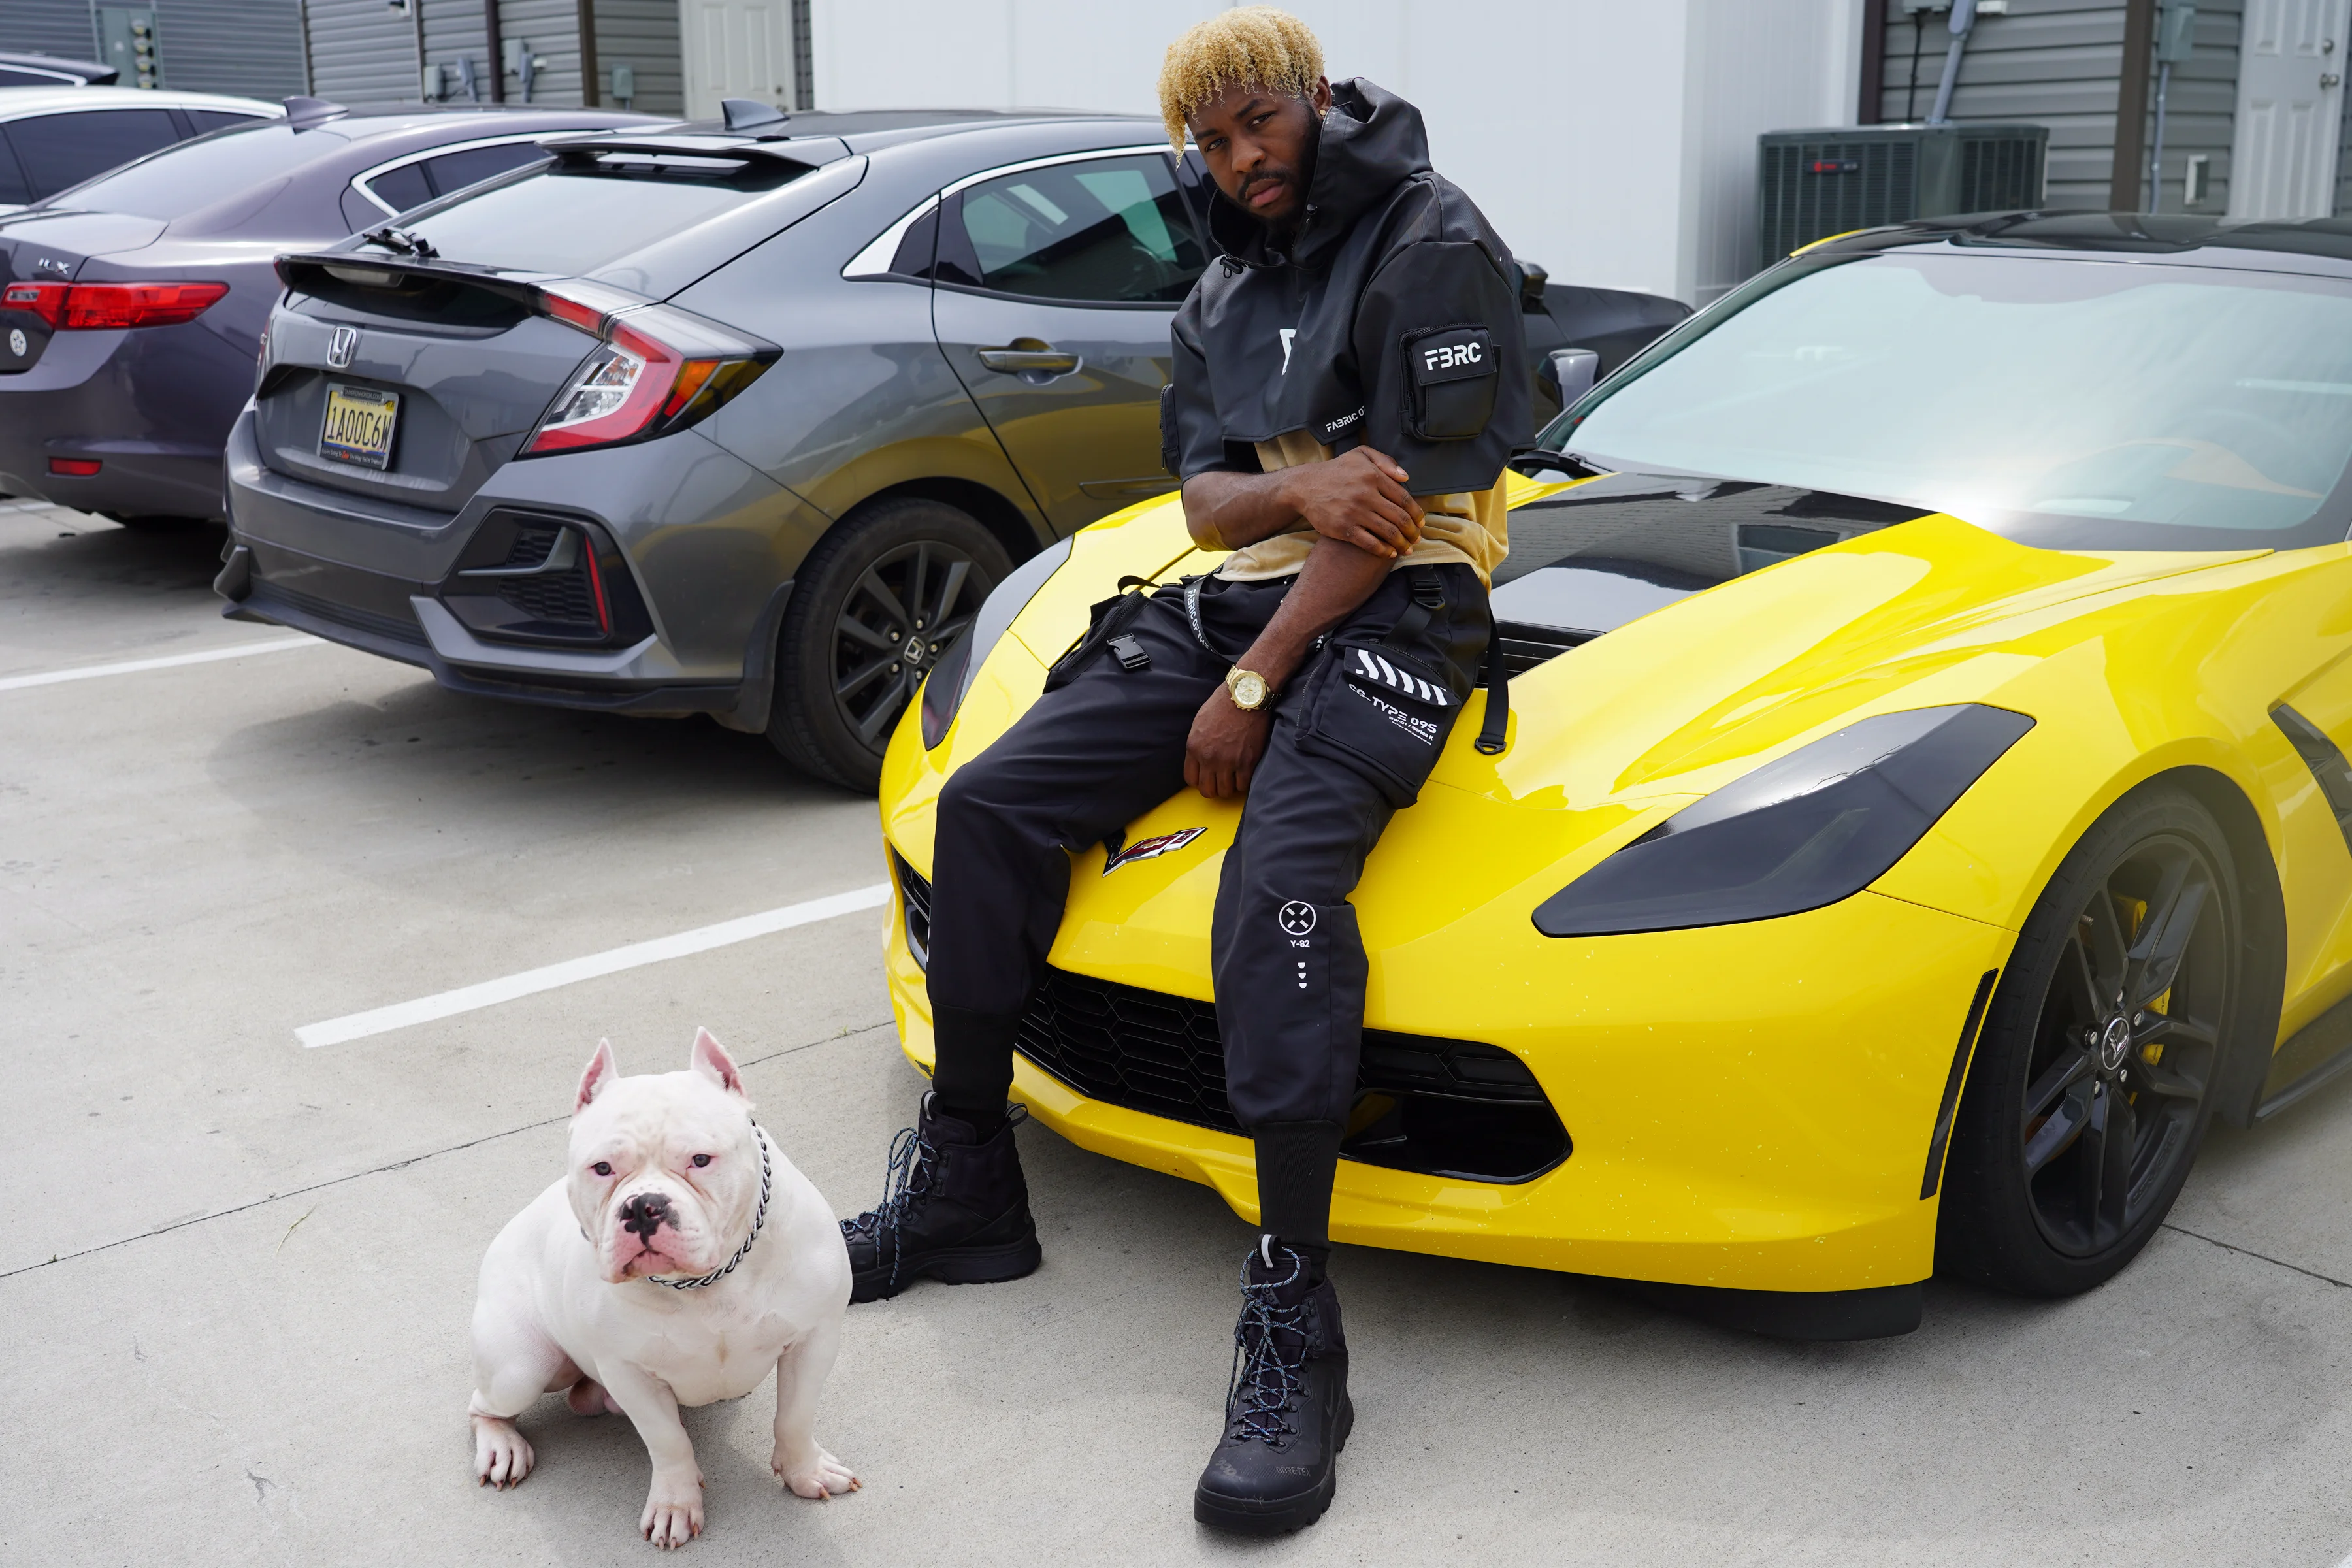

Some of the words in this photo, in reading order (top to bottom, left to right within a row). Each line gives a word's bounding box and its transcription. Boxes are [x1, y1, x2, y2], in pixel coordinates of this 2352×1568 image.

[1424, 342, 1482, 371] FBRC
[327, 406, 392, 451] 1A00C6W
[1325, 412, 1358, 433] FABRIC
[1187, 589, 1196, 619] FABRIC
[1192, 618, 1200, 631] OF
[1411, 725, 1429, 738] Series
[1290, 939, 1311, 948] Y-82
[1275, 1465, 1311, 1477] GORE-TEX
